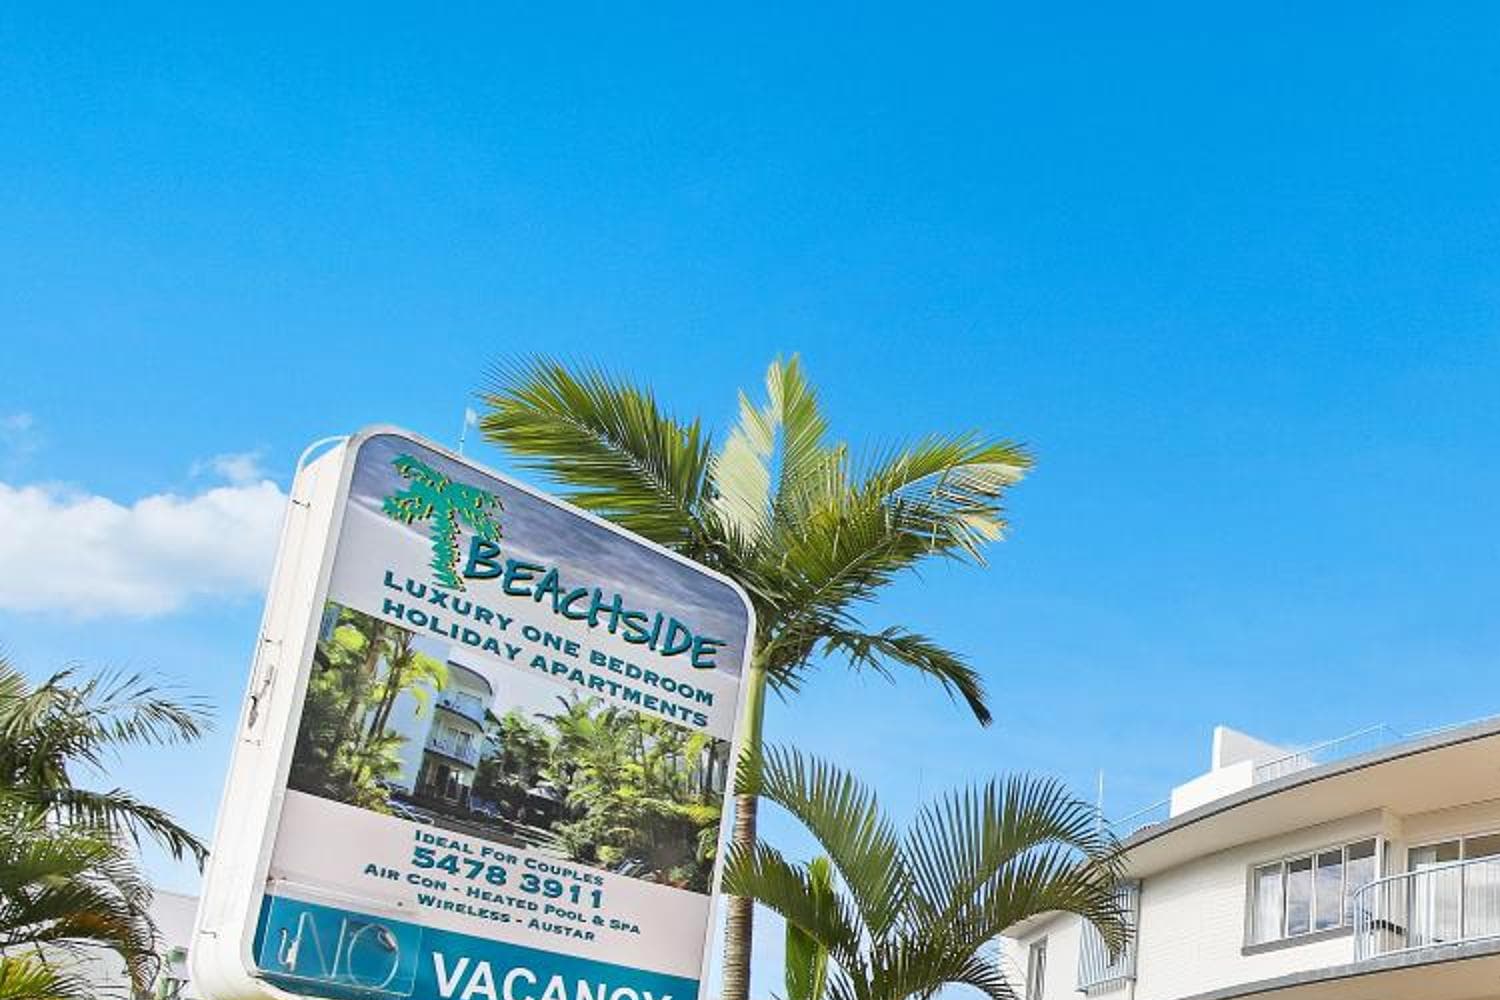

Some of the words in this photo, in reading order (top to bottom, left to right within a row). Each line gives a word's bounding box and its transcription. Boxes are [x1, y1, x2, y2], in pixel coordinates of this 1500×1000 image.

[384, 571, 513, 631] LUXURY
[521, 624, 580, 658] ONE
[589, 649, 714, 706] BEDROOM
[464, 535, 726, 669] BEACHSIDE
[382, 598, 522, 660] HOLIDAY
[530, 655, 708, 727] APARTMENTS
[411, 846, 507, 886] 5478
[519, 873, 602, 908] 3911
[415, 829, 474, 854] IDEAL
[481, 846, 518, 865] FOR
[525, 858, 604, 886] COUPLES
[364, 863, 400, 880] AIR
[407, 873, 447, 891] CON
[467, 886, 538, 911] HEATED
[543, 904, 587, 923] POOL
[593, 914, 605, 926] &
[610, 919, 641, 935] SPA
[417, 893, 511, 923] WIRELESS
[528, 918, 595, 942] AUSTAR
[291, 911, 399, 989] NO
